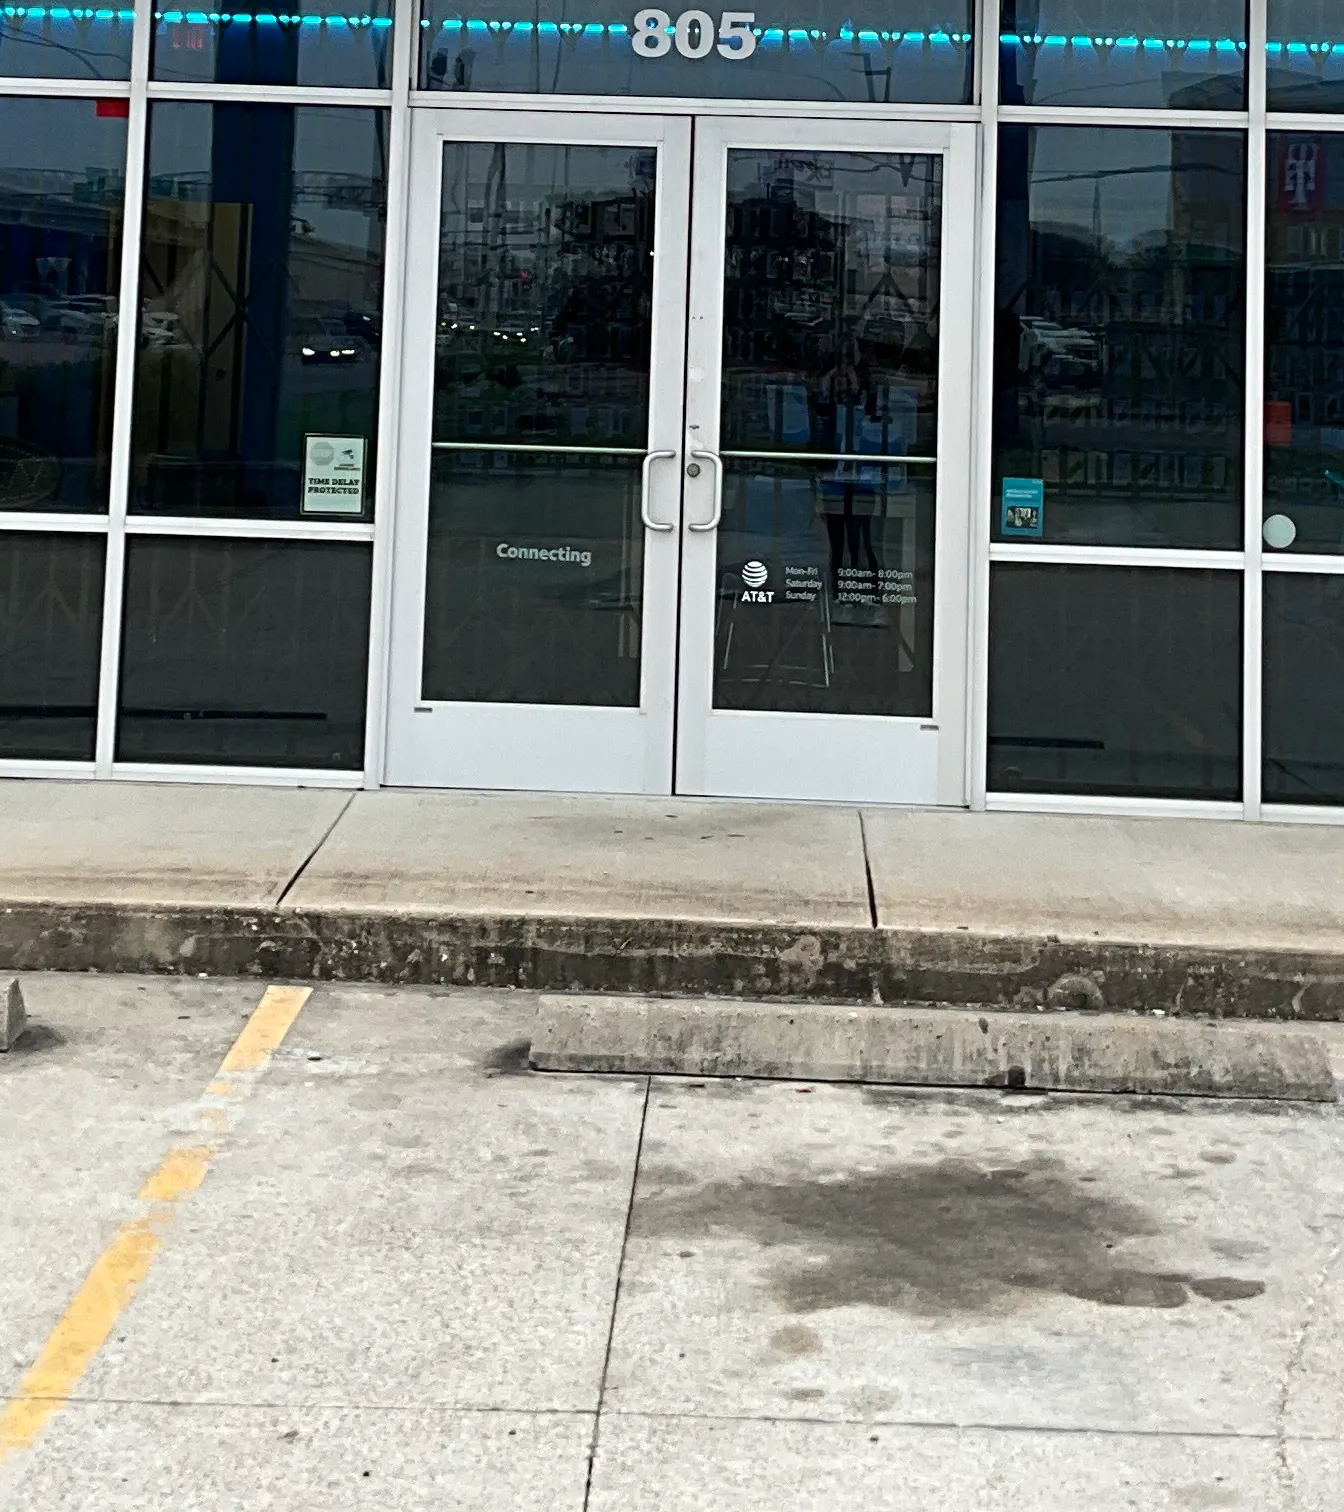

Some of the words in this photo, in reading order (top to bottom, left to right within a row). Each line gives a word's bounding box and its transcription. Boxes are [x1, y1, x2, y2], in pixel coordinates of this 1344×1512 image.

[632, 8, 757, 60] 805
[308, 477, 330, 486] TIME
[332, 478, 360, 486] DELAY
[307, 486, 360, 495] PROTECTED
[496, 543, 592, 567] Connecting
[785, 566, 818, 576] Mon-Fri
[785, 578, 823, 590] Saturday
[741, 590, 775, 603] AT&T
[785, 590, 817, 602] Sunday
